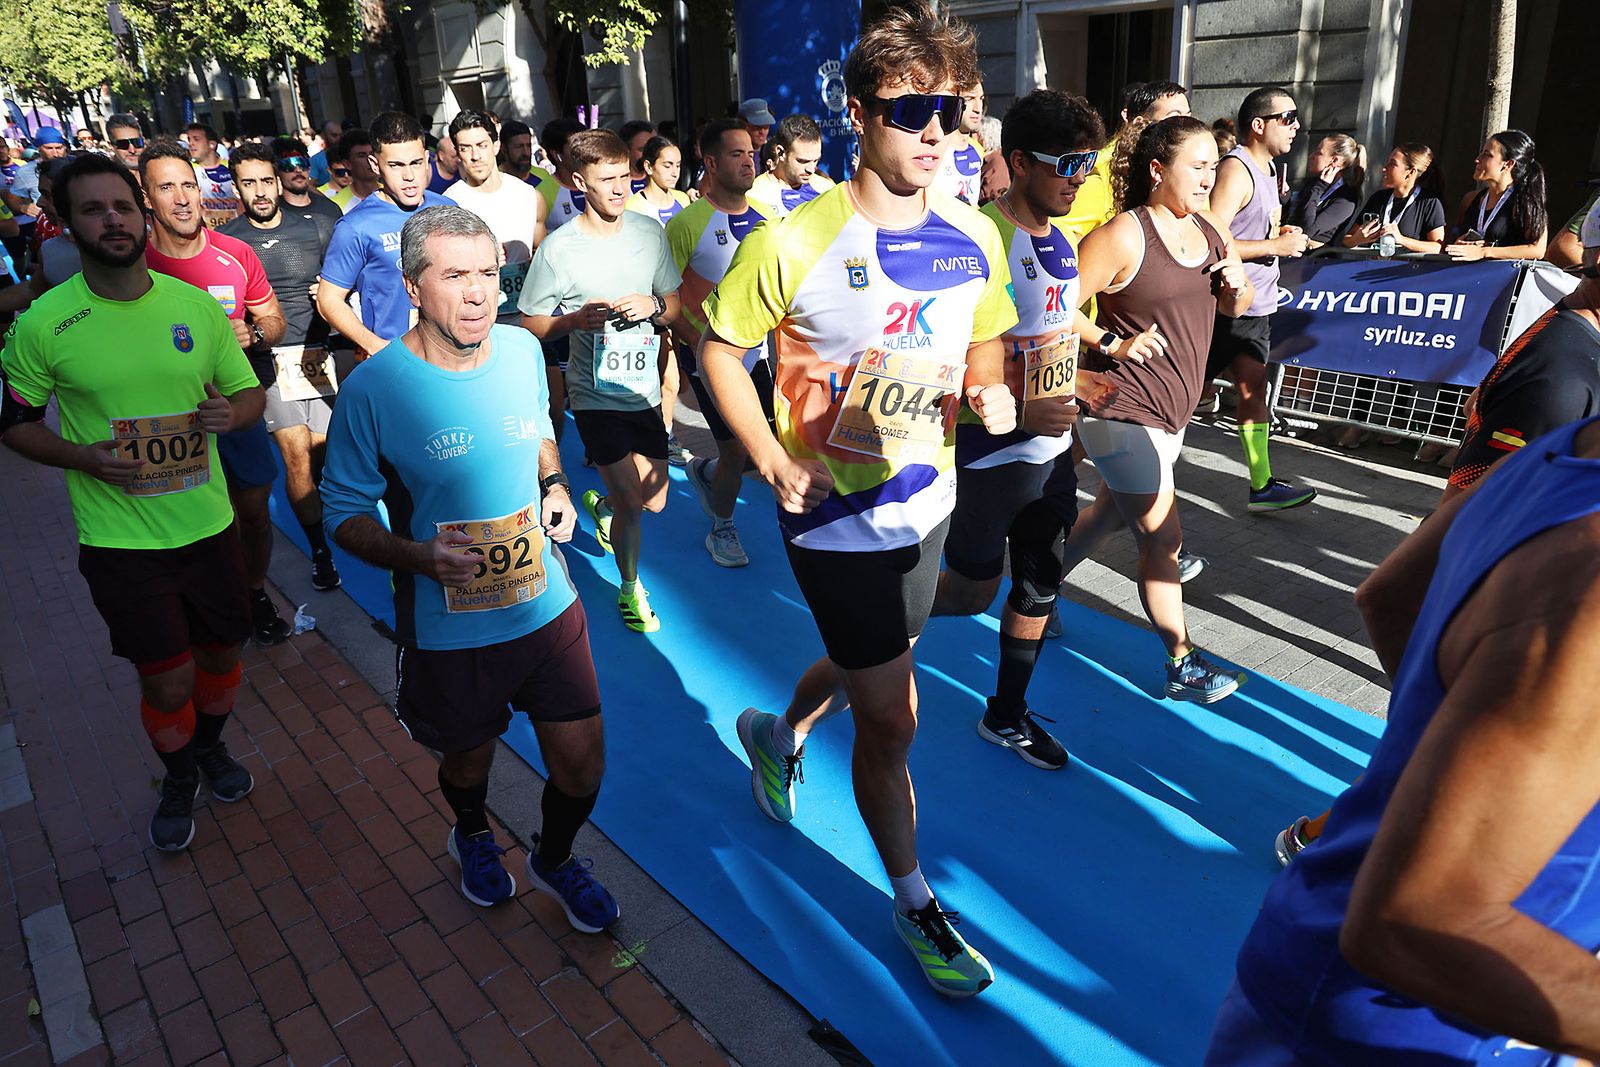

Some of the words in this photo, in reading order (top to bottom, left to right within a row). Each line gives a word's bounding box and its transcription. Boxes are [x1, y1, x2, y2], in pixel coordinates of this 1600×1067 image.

[932, 256, 983, 273] AVATEL
[1046, 284, 1068, 312] 21K
[1296, 290, 1467, 321] HYUNDAI
[883, 297, 936, 335] 21K
[883, 335, 932, 350] HUELVA
[1363, 325, 1457, 350] syrluz.es
[606, 351, 646, 371] 618
[1031, 357, 1074, 396] 1038
[861, 377, 945, 423] 1044
[837, 427, 885, 447] Huelva
[872, 425, 909, 440] GOMEZ
[124, 431, 205, 465] 1002
[424, 432, 475, 455] TURKEY
[437, 444, 468, 461] LOVERS
[134, 470, 173, 480] ALACIOS
[175, 463, 203, 477] PINEDA
[516, 508, 532, 527] 21K
[456, 583, 507, 596] PALACIOS
[508, 571, 541, 588] PINEDA
[452, 593, 500, 606] Huelva
